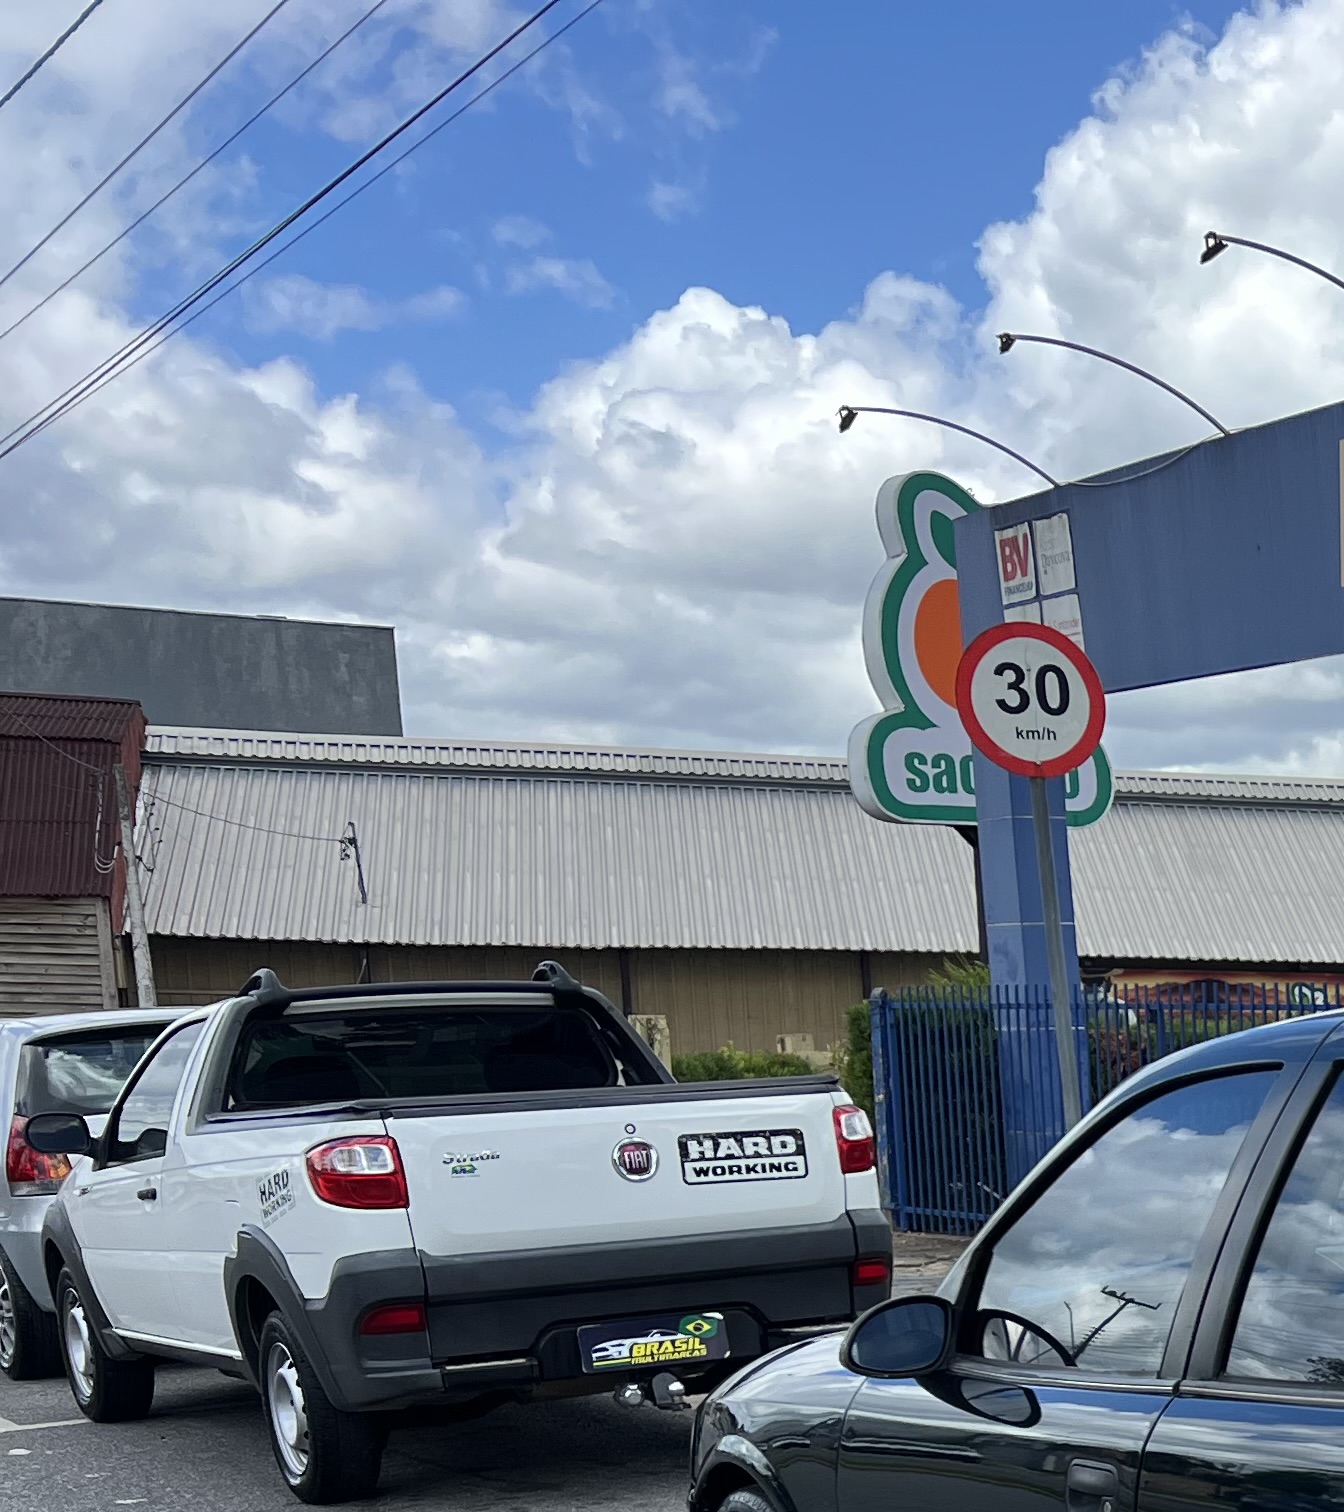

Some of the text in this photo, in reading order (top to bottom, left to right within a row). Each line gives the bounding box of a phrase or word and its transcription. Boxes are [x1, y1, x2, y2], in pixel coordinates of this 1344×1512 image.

[1000, 532, 1029, 583] BV
[993, 662, 1070, 716] 30
[1015, 726, 1057, 741] km/h
[687, 1134, 797, 1160] HARD
[624, 1151, 649, 1170] FIAT
[692, 1161, 799, 1178] WORKING
[259, 1169, 289, 1206] HARD
[631, 1348, 707, 1365] MULTIMARCAS
[632, 1337, 706, 1357] BRASIL
